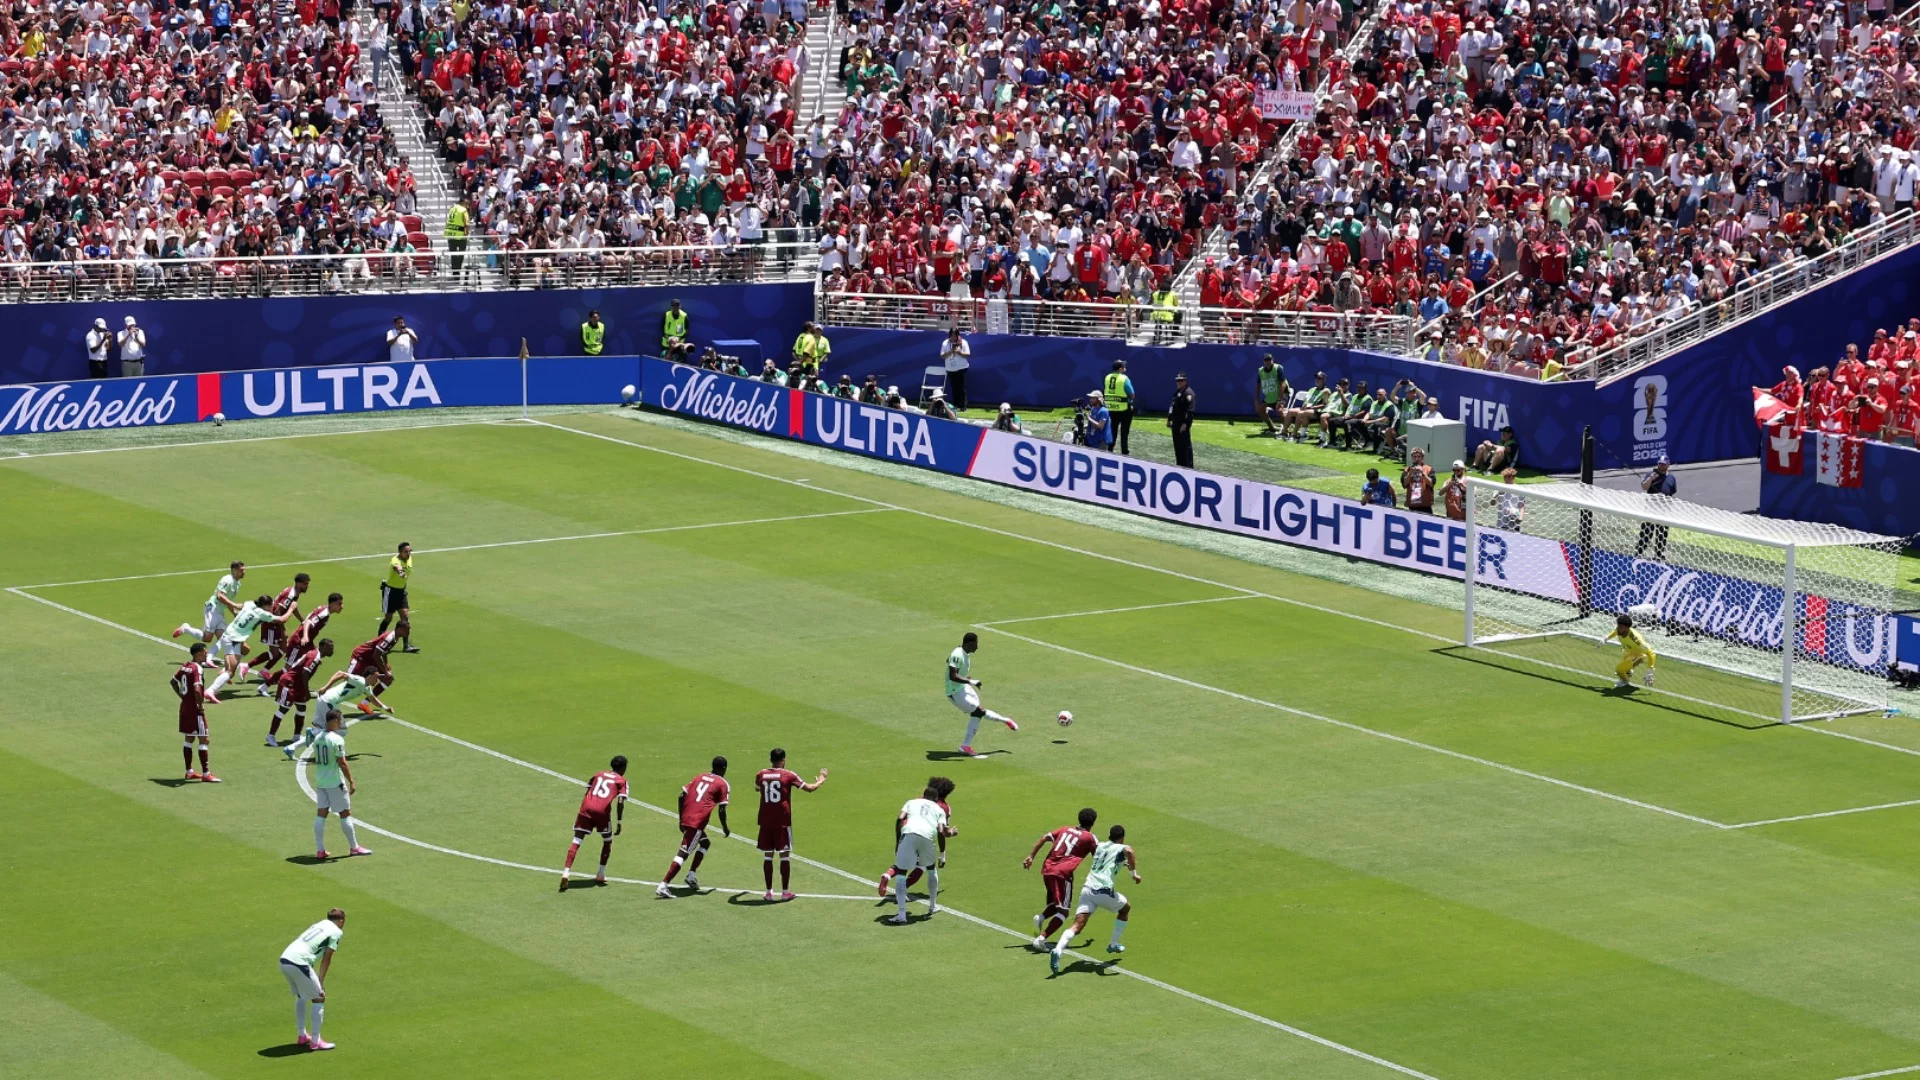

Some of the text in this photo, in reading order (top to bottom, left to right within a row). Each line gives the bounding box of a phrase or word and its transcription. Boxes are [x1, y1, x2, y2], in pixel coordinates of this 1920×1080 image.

[931, 303, 948, 313] 123
[1319, 319, 1336, 329] 124
[0, 363, 442, 432] Michelob ULTRA
[660, 363, 937, 465] Michelob ULTRA
[1460, 395, 1511, 431] FIFA
[1643, 426, 1658, 435] FIFA
[1633, 442, 1655, 451] WORLD
[1012, 440, 1507, 580] SUPERIOR LIGHT BEER
[1845, 607, 1920, 673] UL
[592, 776, 615, 798] 15
[696, 781, 710, 802] 4
[762, 780, 781, 803] 16
[1053, 832, 1078, 857] 14
